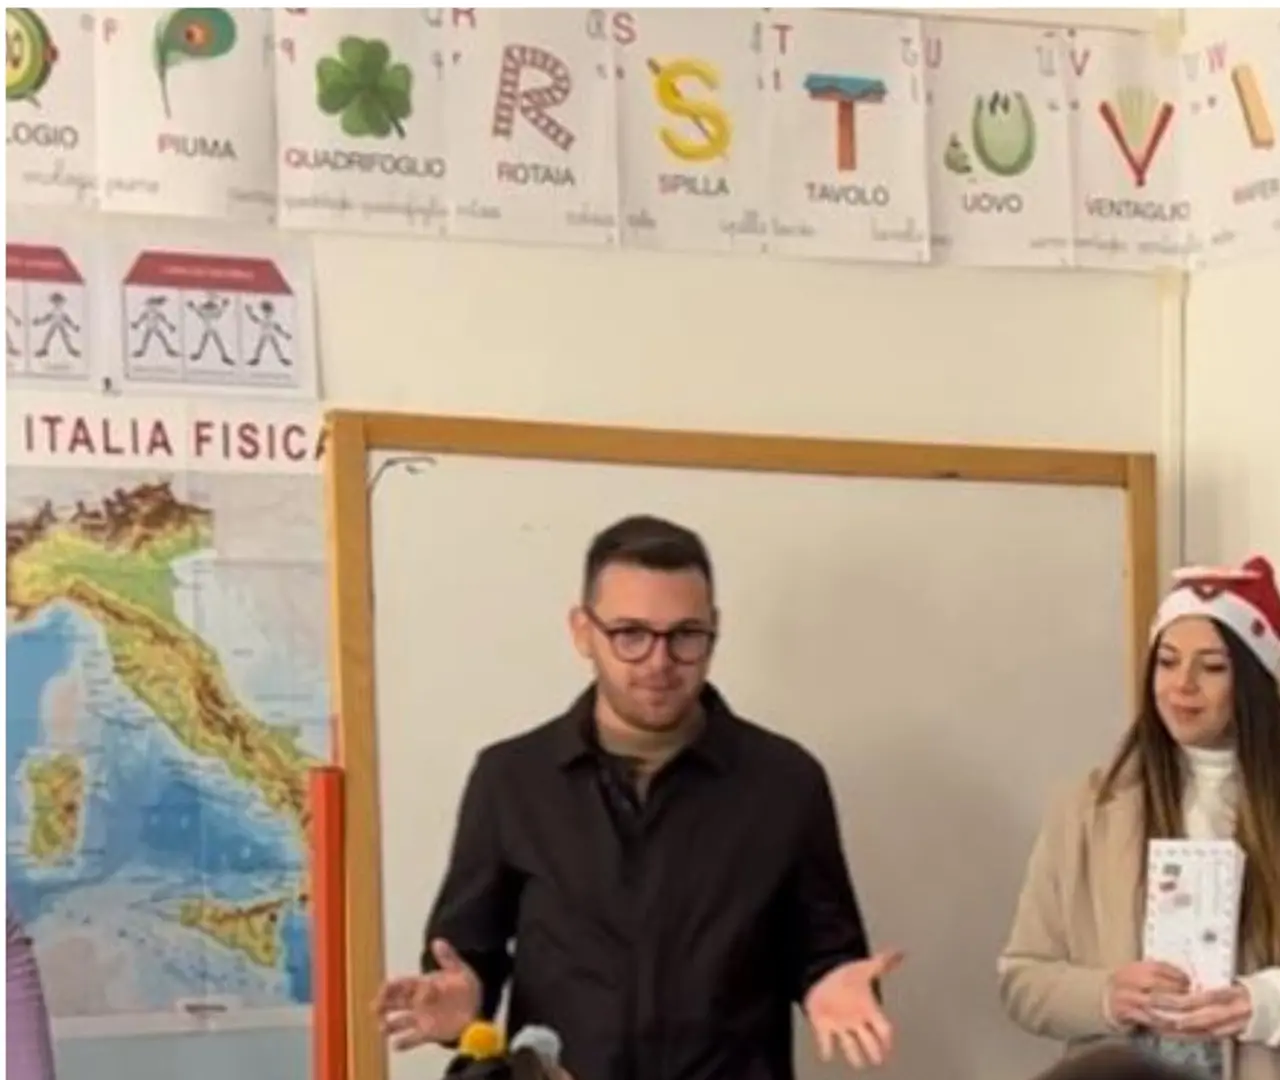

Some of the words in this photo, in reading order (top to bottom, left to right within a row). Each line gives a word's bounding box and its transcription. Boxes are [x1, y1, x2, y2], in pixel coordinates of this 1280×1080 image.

[772, 24, 793, 55] T
[6, 122, 78, 149] OGIO
[158, 133, 238, 160] PIUMA
[284, 148, 447, 180] QUADRIFOGLIO
[497, 161, 576, 187] ROTAIA
[658, 173, 731, 197] SPILLA
[804, 181, 891, 207] TAVOLO
[962, 192, 1025, 215] UOVO
[1085, 196, 1191, 222] VENTAGLIO
[24, 413, 174, 457] ITALIA
